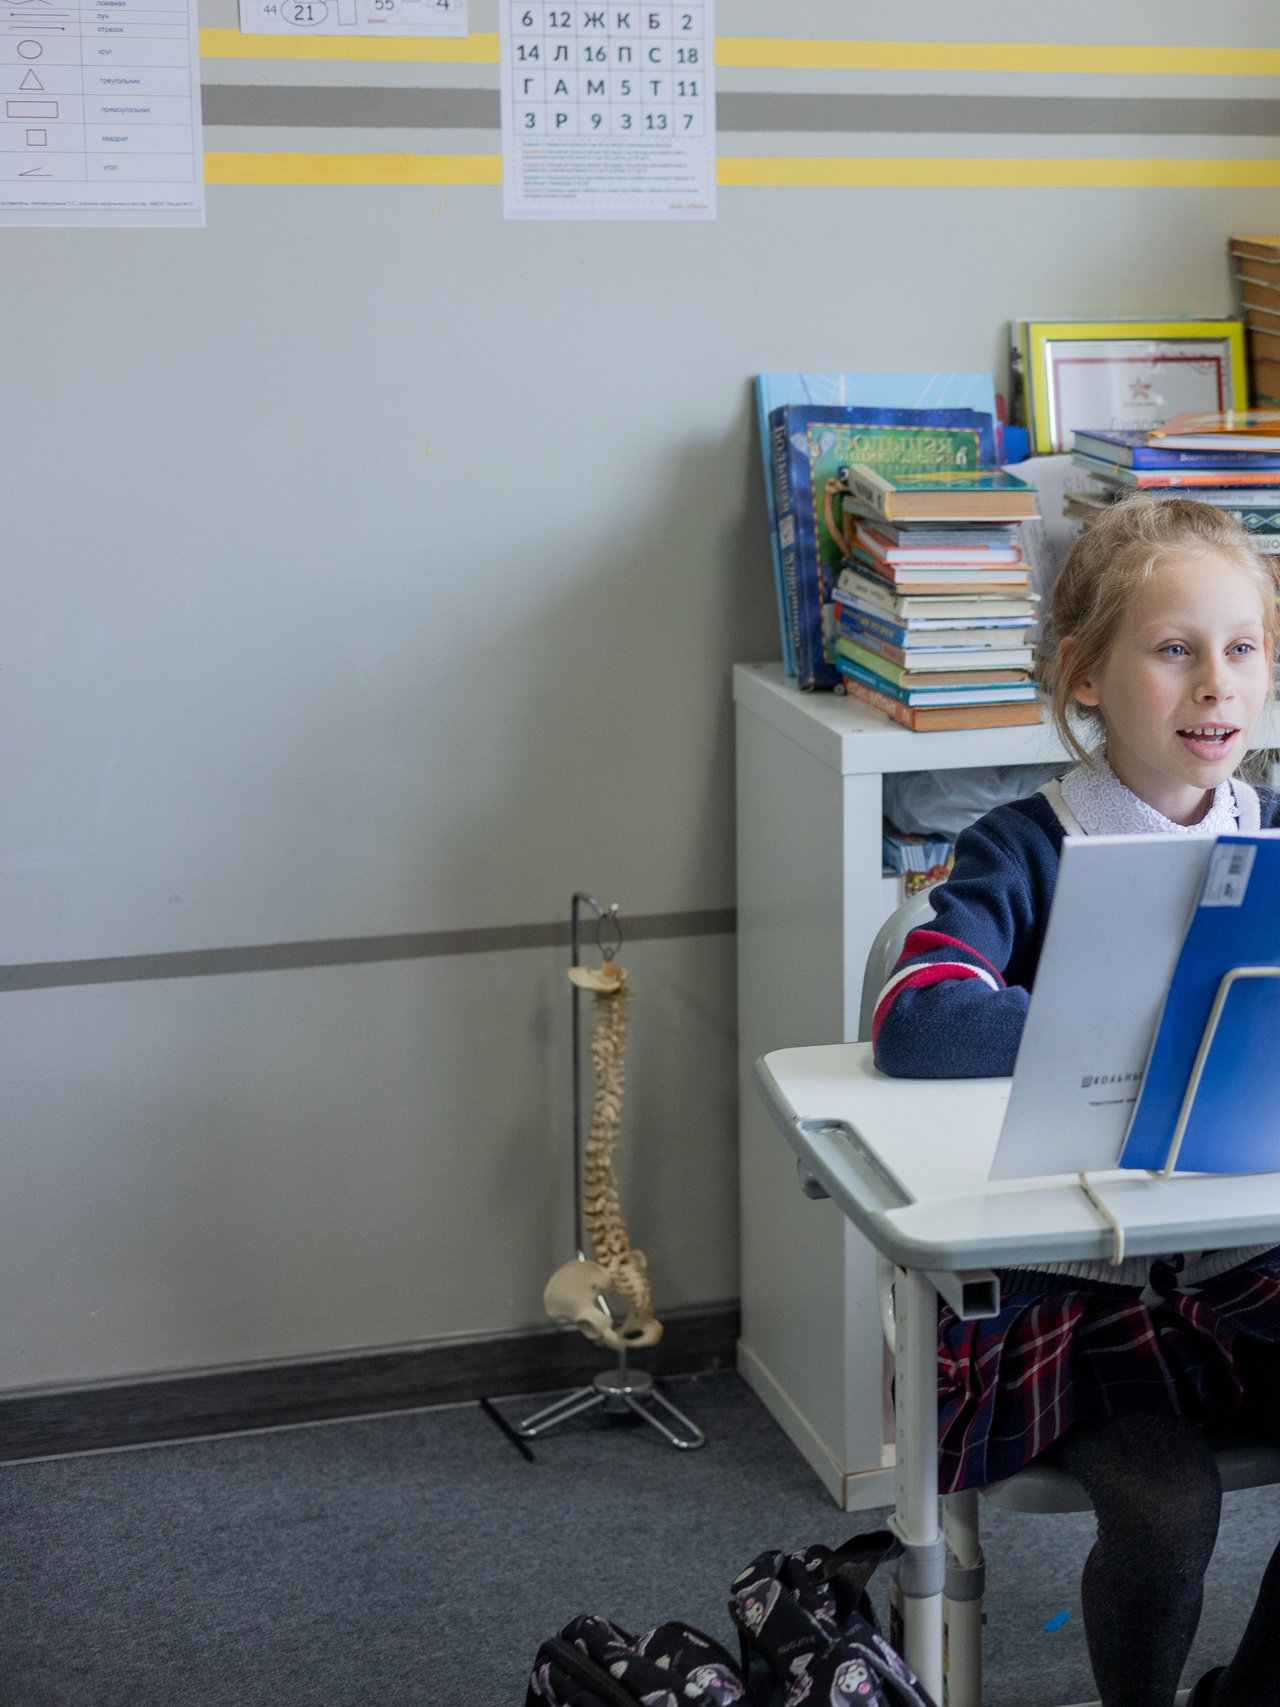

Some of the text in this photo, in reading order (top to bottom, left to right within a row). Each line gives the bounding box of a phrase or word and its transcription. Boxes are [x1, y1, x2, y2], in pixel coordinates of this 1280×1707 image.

[263, 5, 277, 14] 44
[294, 5, 314, 21] 21
[522, 11, 692, 30] 6 12 Ж К Б 2
[517, 45, 698, 64] 14 Л 16 П С 18
[524, 78, 698, 97] Г А М 5 Т 11
[556, 113, 568, 129] Р
[591, 113, 602, 129] 9
[646, 114, 667, 130] 13
[683, 115, 693, 130] 7
